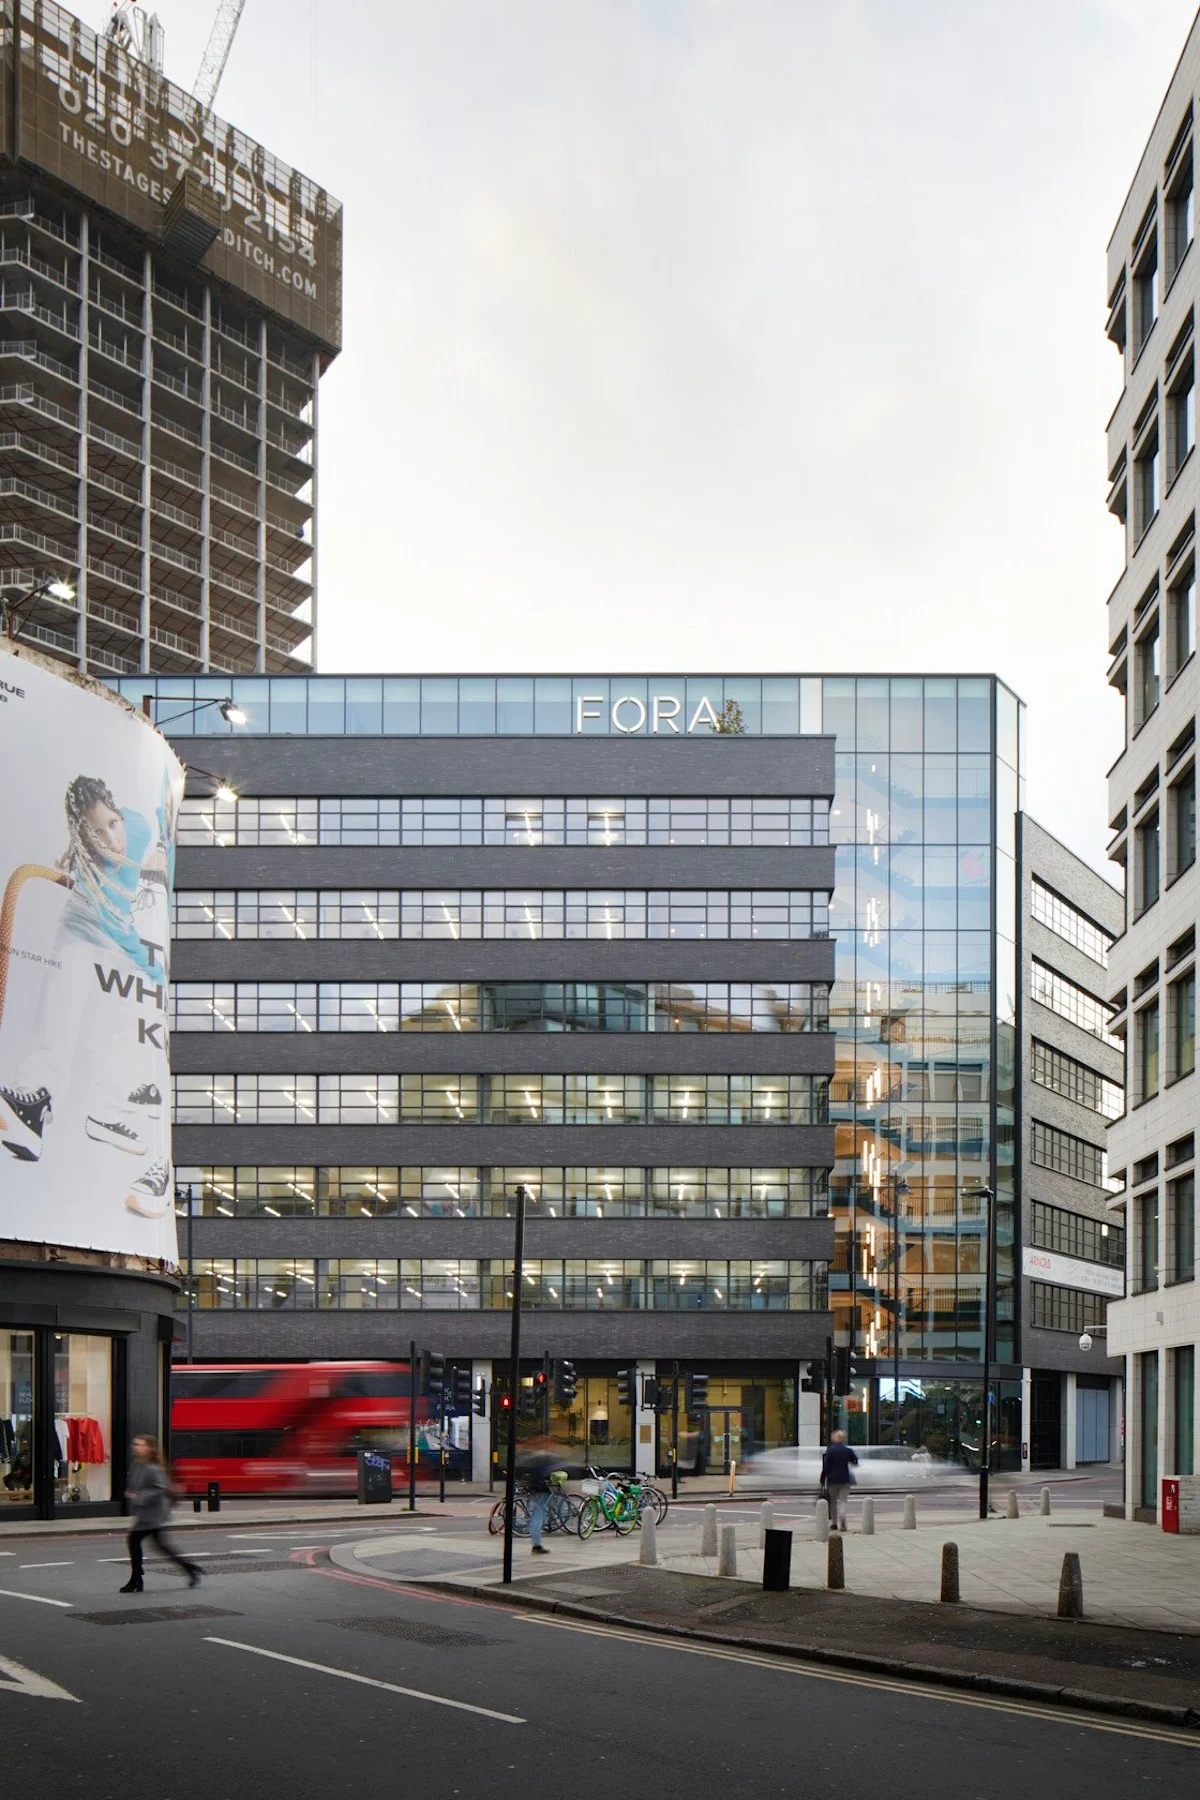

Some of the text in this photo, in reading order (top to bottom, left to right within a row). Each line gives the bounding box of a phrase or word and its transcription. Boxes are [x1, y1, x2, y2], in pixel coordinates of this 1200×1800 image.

[59, 121, 317, 299] THESTAGESDITCH.COM
[577, 696, 721, 734] FORA
[21, 950, 42, 962] STAR
[44, 957, 62, 970] HIKE
[140, 938, 163, 968] T
[94, 962, 163, 1010] WH
[138, 1017, 163, 1050] K
